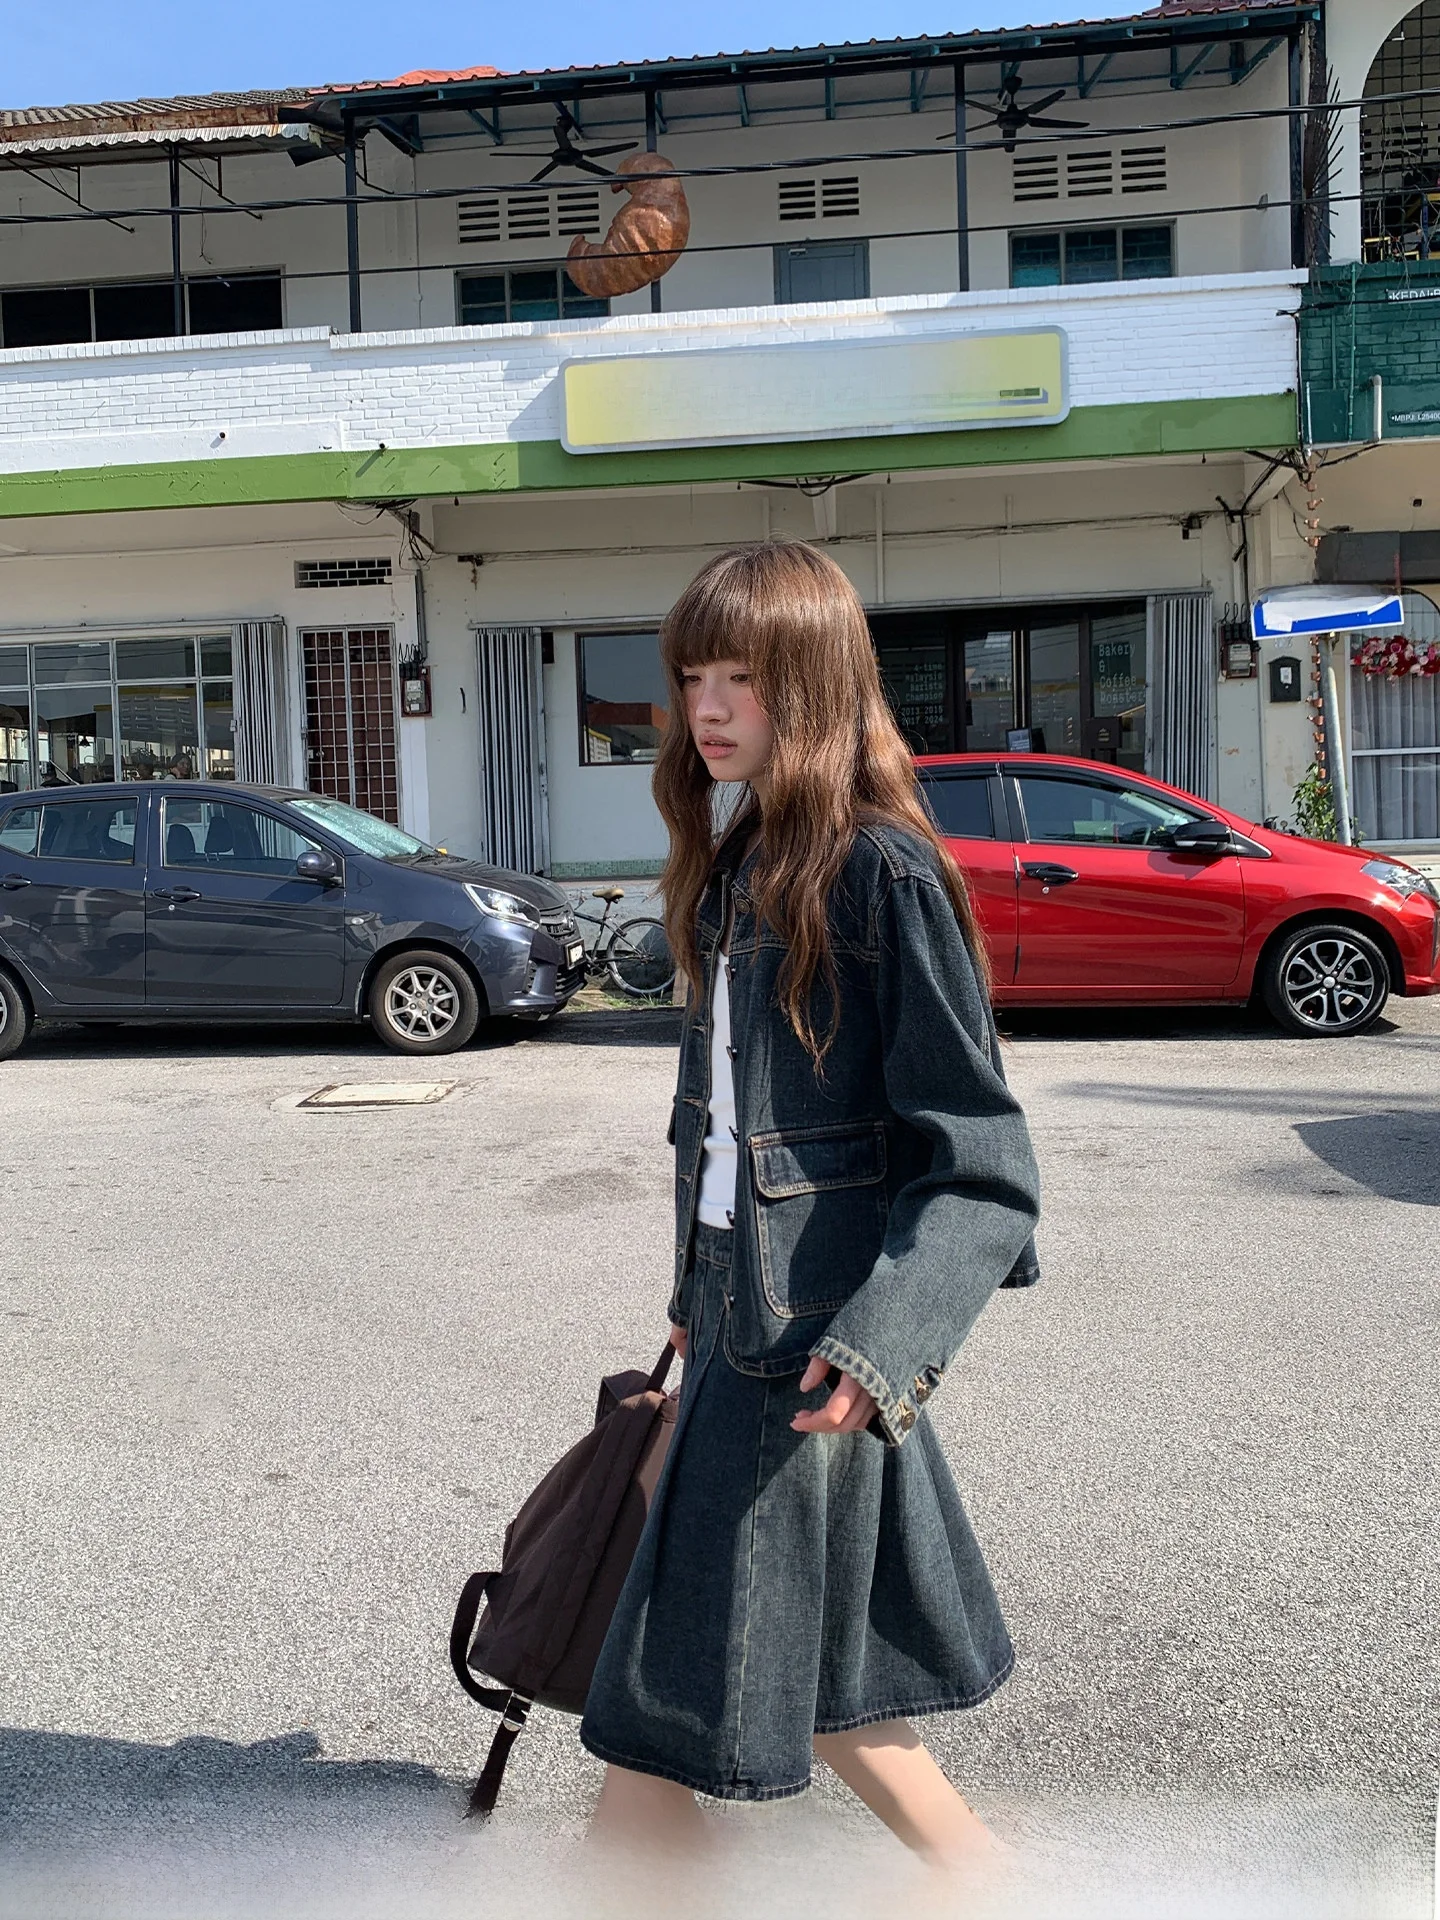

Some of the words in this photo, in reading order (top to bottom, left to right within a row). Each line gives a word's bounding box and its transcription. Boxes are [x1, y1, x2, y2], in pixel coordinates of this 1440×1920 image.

[1098, 641, 1136, 657] Bakery
[1098, 660, 1106, 673] &
[905, 671, 943, 683] Malaysia
[1100, 672, 1137, 688] Coffee
[910, 682, 943, 691] Barista
[905, 692, 943, 702] Champion
[924, 715, 943, 725] 2024
